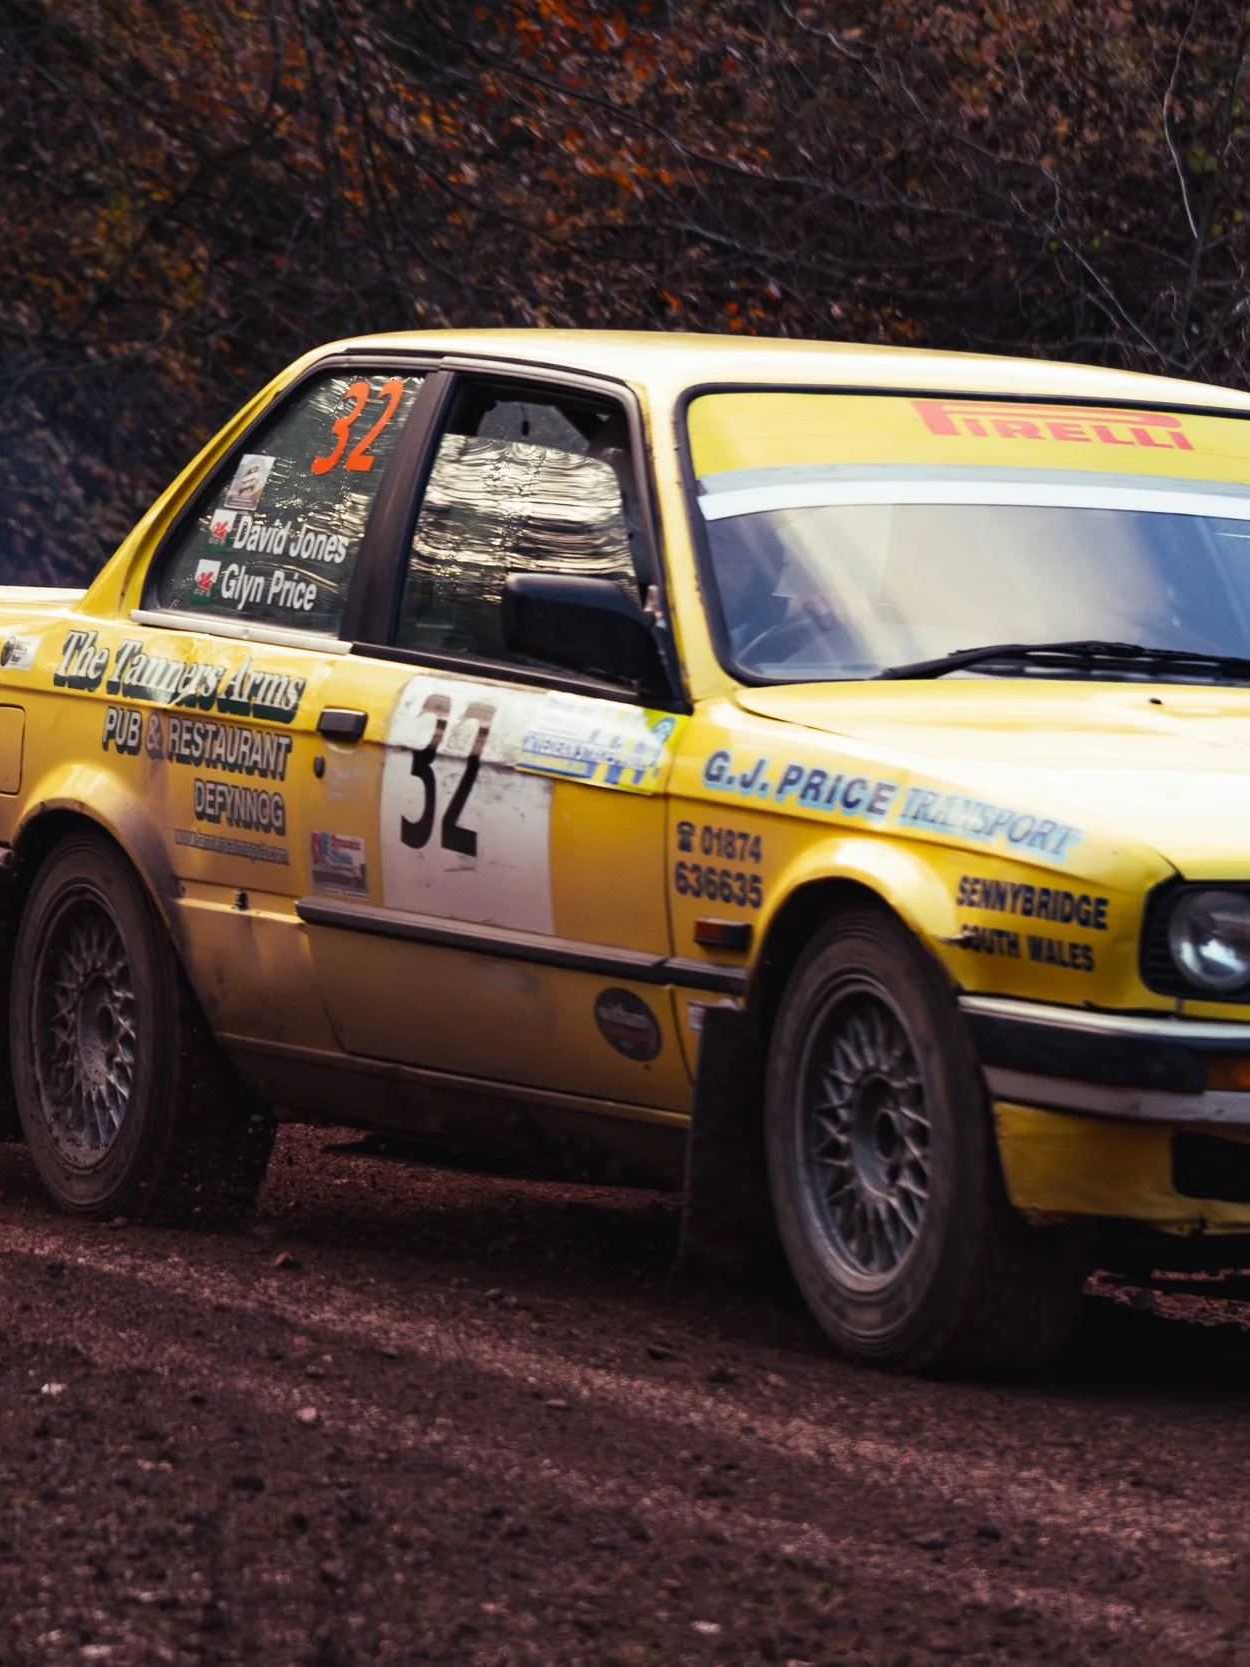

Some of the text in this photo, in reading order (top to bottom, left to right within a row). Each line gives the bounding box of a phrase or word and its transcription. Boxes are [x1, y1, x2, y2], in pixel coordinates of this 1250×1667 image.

[311, 380, 405, 476] 32
[911, 400, 1195, 451] PIRELLI
[232, 515, 350, 564] David Jones
[221, 563, 318, 611] Glyn Price
[55, 630, 110, 687] The
[107, 639, 226, 704] Tanners
[218, 657, 306, 718] Arms
[103, 707, 291, 778] PUB & RESTAURANT
[400, 693, 498, 858] 32
[704, 750, 769, 794] G.J.
[776, 764, 898, 817] PRICE
[194, 779, 286, 834] DEFYNNOG
[702, 825, 761, 864] 01874
[675, 861, 762, 908] 636635
[956, 875, 1109, 930] SENNYBRIDGE
[1026, 934, 1095, 972] WALES
